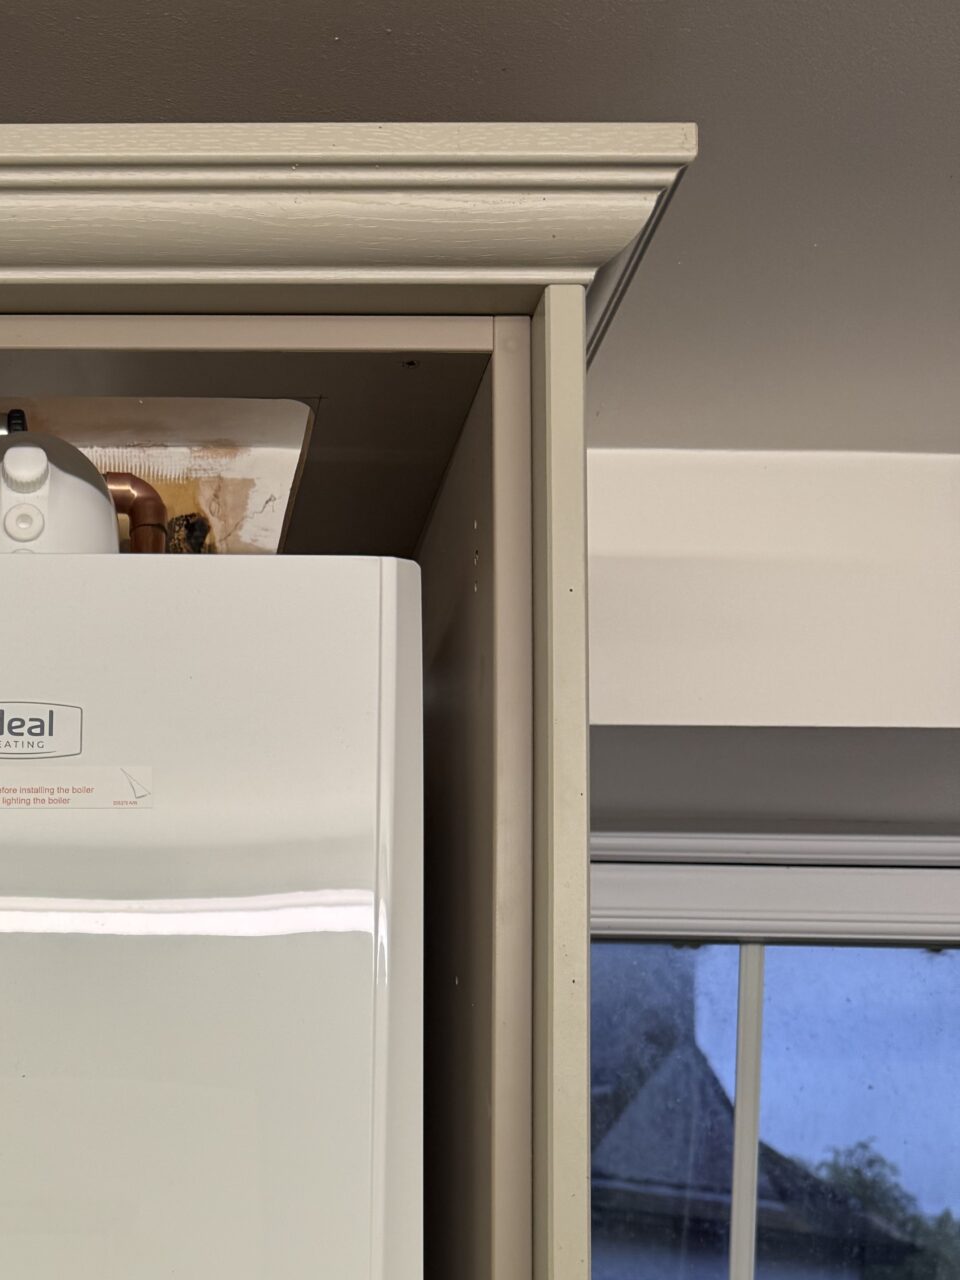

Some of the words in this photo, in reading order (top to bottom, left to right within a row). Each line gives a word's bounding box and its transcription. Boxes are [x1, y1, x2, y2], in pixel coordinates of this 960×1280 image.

[19, 786, 55, 796] installing
[56, 786, 70, 795] the
[71, 786, 95, 795] boiler
[2, 796, 31, 806] lighting
[32, 796, 46, 805] the
[47, 796, 71, 805] boiler
